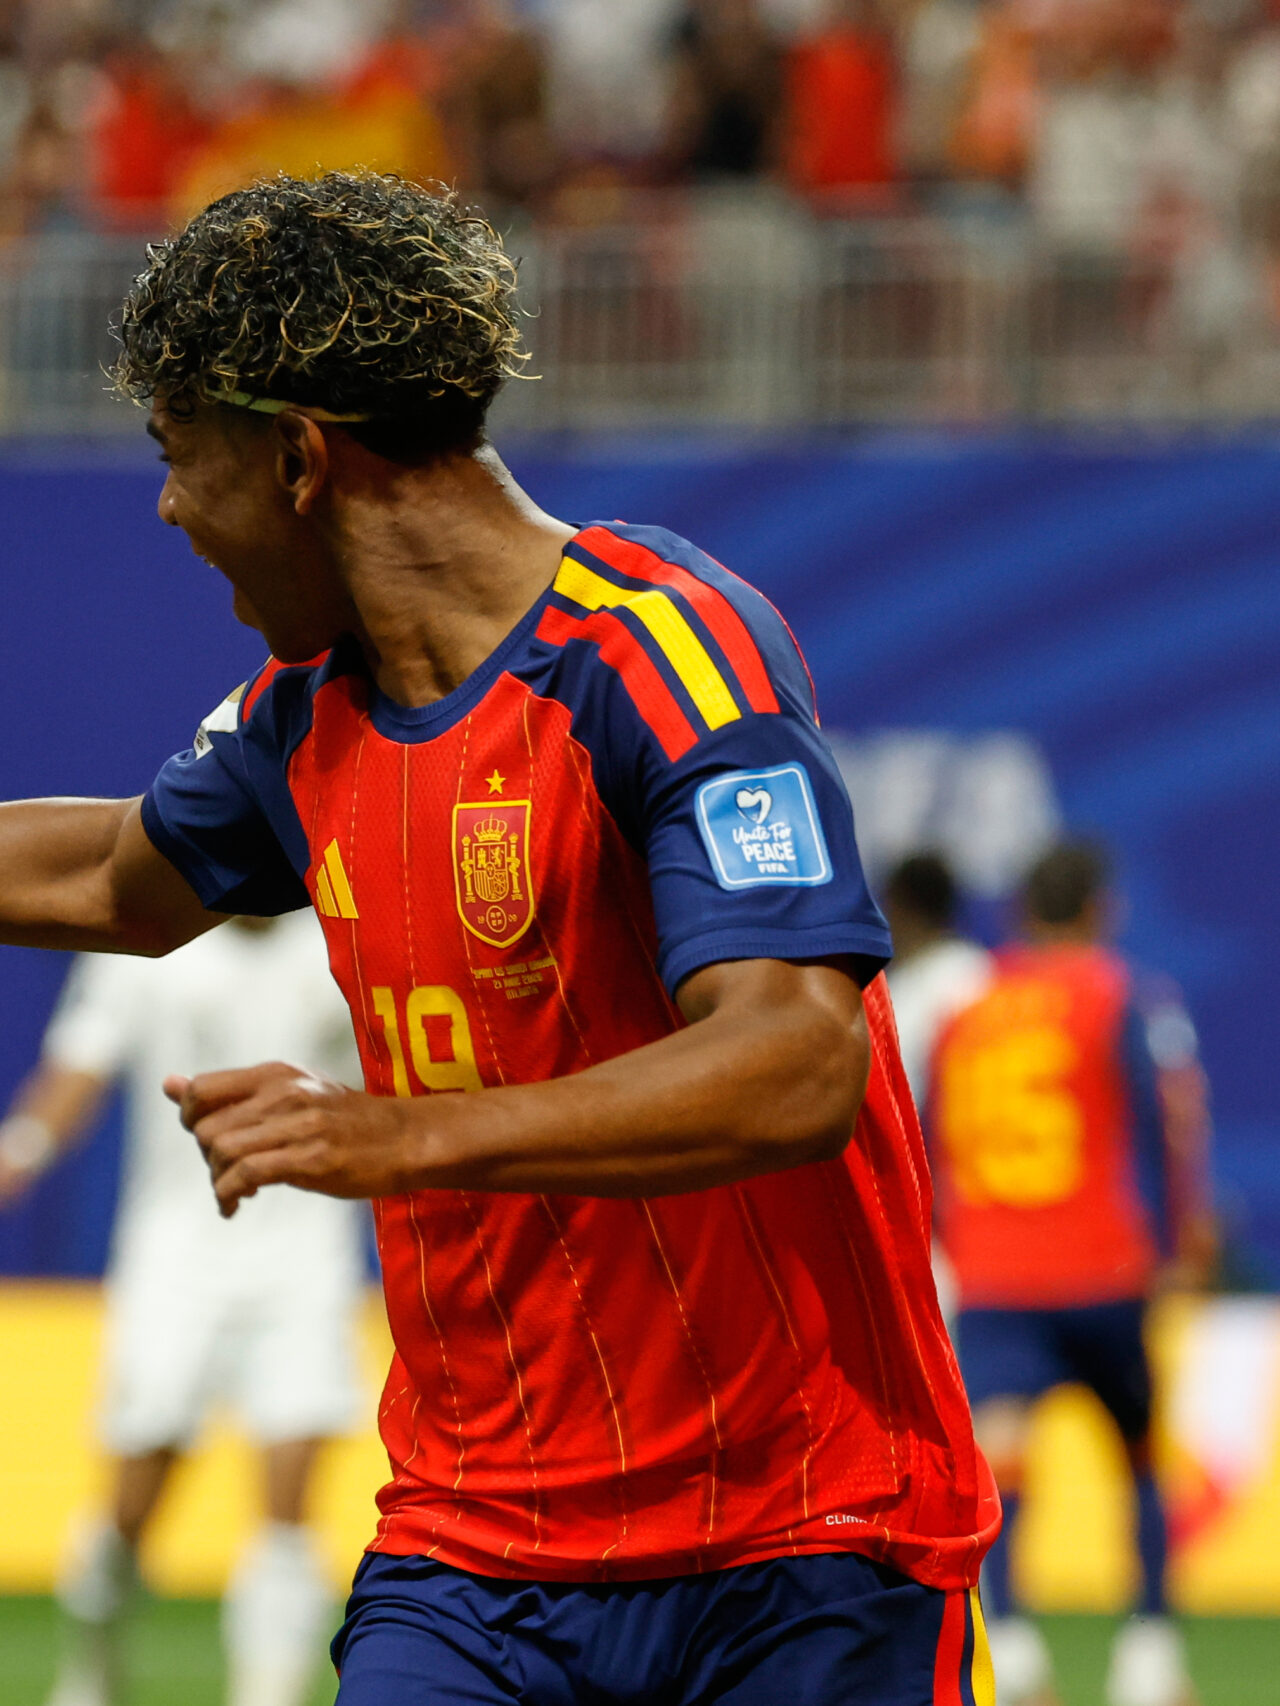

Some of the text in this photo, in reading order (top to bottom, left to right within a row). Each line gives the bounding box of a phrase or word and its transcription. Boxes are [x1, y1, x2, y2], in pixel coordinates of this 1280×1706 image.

[742, 842, 796, 862] PEACE
[758, 863, 788, 873] FIFA
[372, 986, 484, 1097] 19
